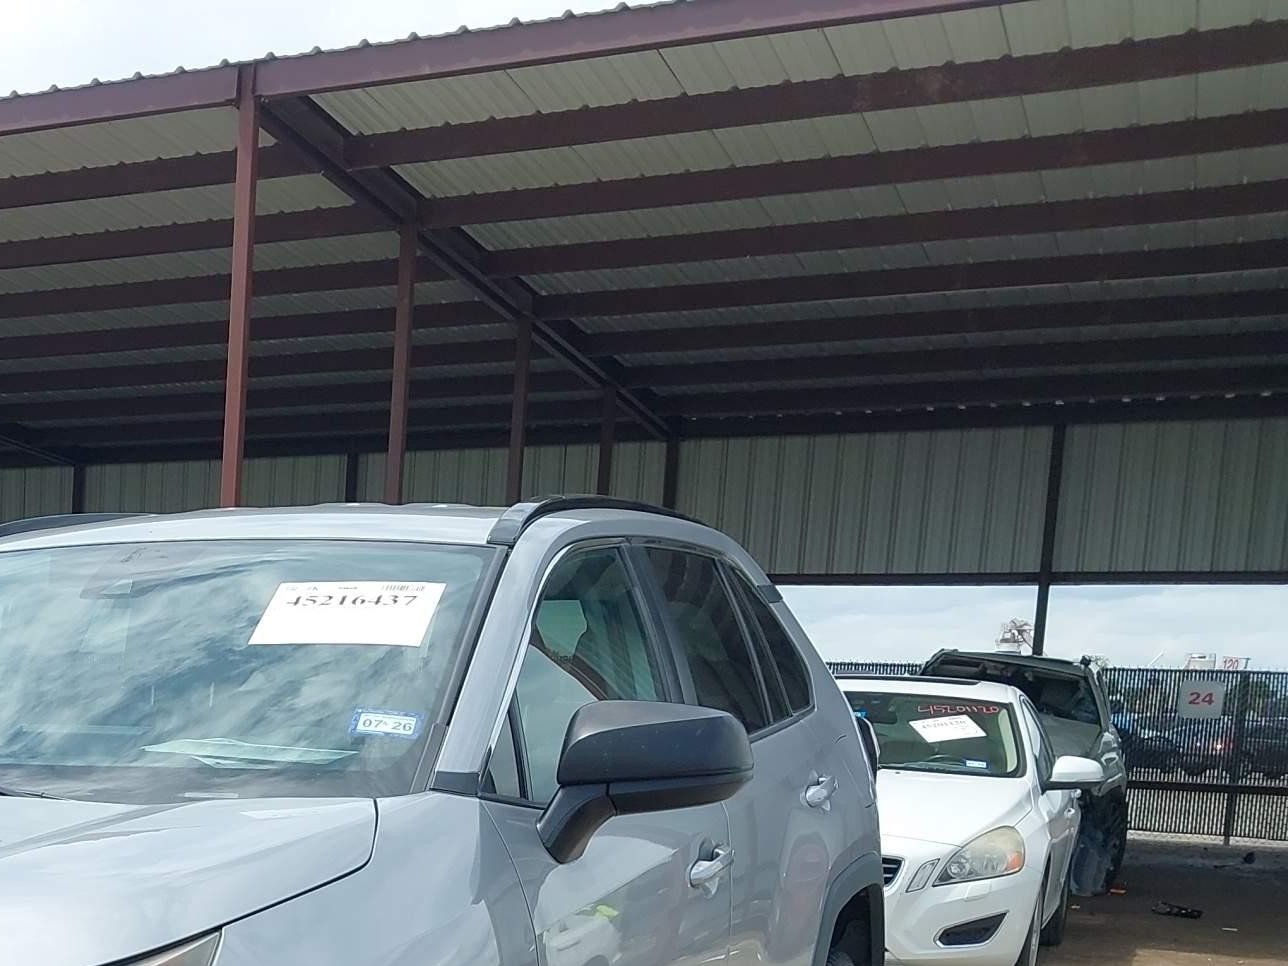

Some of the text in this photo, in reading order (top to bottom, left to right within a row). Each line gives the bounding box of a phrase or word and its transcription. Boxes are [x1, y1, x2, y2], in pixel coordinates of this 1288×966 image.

[286, 594, 419, 606] 45216437
[1188, 691, 1215, 706] 24
[362, 718, 413, 732] 07 26
